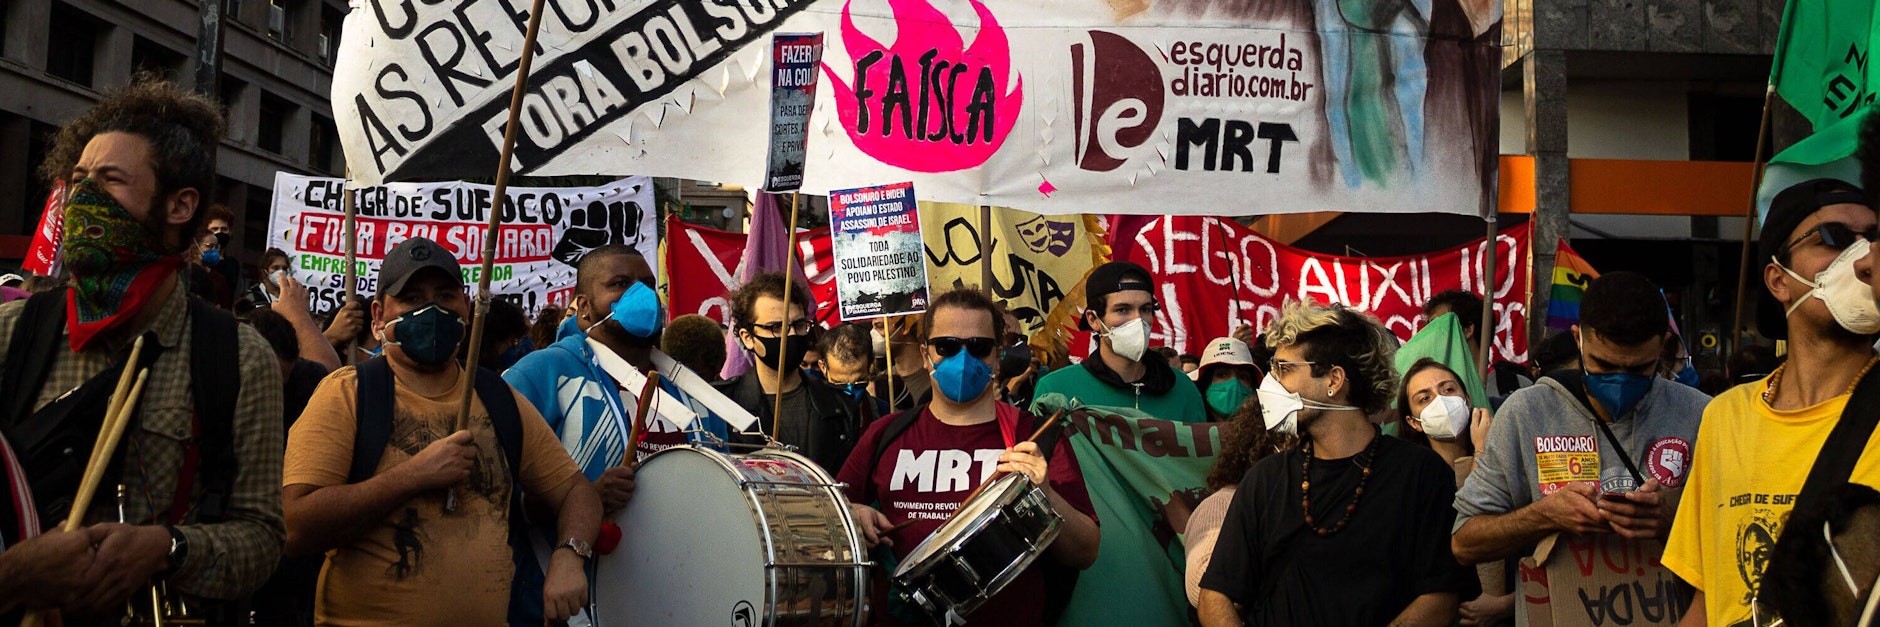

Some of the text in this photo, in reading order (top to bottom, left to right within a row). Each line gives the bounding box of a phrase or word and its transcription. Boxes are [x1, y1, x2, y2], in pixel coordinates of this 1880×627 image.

[781, 45, 813, 63] FAZER
[1170, 33, 1303, 72] esquerda
[778, 68, 792, 87] NA
[1170, 66, 1314, 101] diario.com.br
[355, 0, 616, 175] AS REFO
[481, 0, 798, 174] FORA BOLSO
[780, 105, 797, 117] PARA
[787, 140, 805, 153] PRIVA
[1175, 117, 1300, 174] MRT
[840, 188, 906, 205] BOLSONARO E BIDEN
[395, 195, 423, 218] DE
[878, 201, 904, 214] ESTADO
[840, 218, 878, 232] ASSASSINO
[888, 213, 912, 227] ISRAEL
[869, 240, 890, 253] TODA
[301, 254, 367, 277] EMPREO
[841, 251, 919, 270] SOLIDARIEDADE AO
[847, 266, 917, 284] POVO PALESTINO
[889, 448, 1006, 493] MRT
[1569, 457, 1582, 475] 6
[893, 501, 961, 511] MOVIMENTO REVOL
[1754, 493, 1770, 505] DE
[1772, 494, 1800, 505] SUF
[907, 511, 953, 520] DE TRABALH
